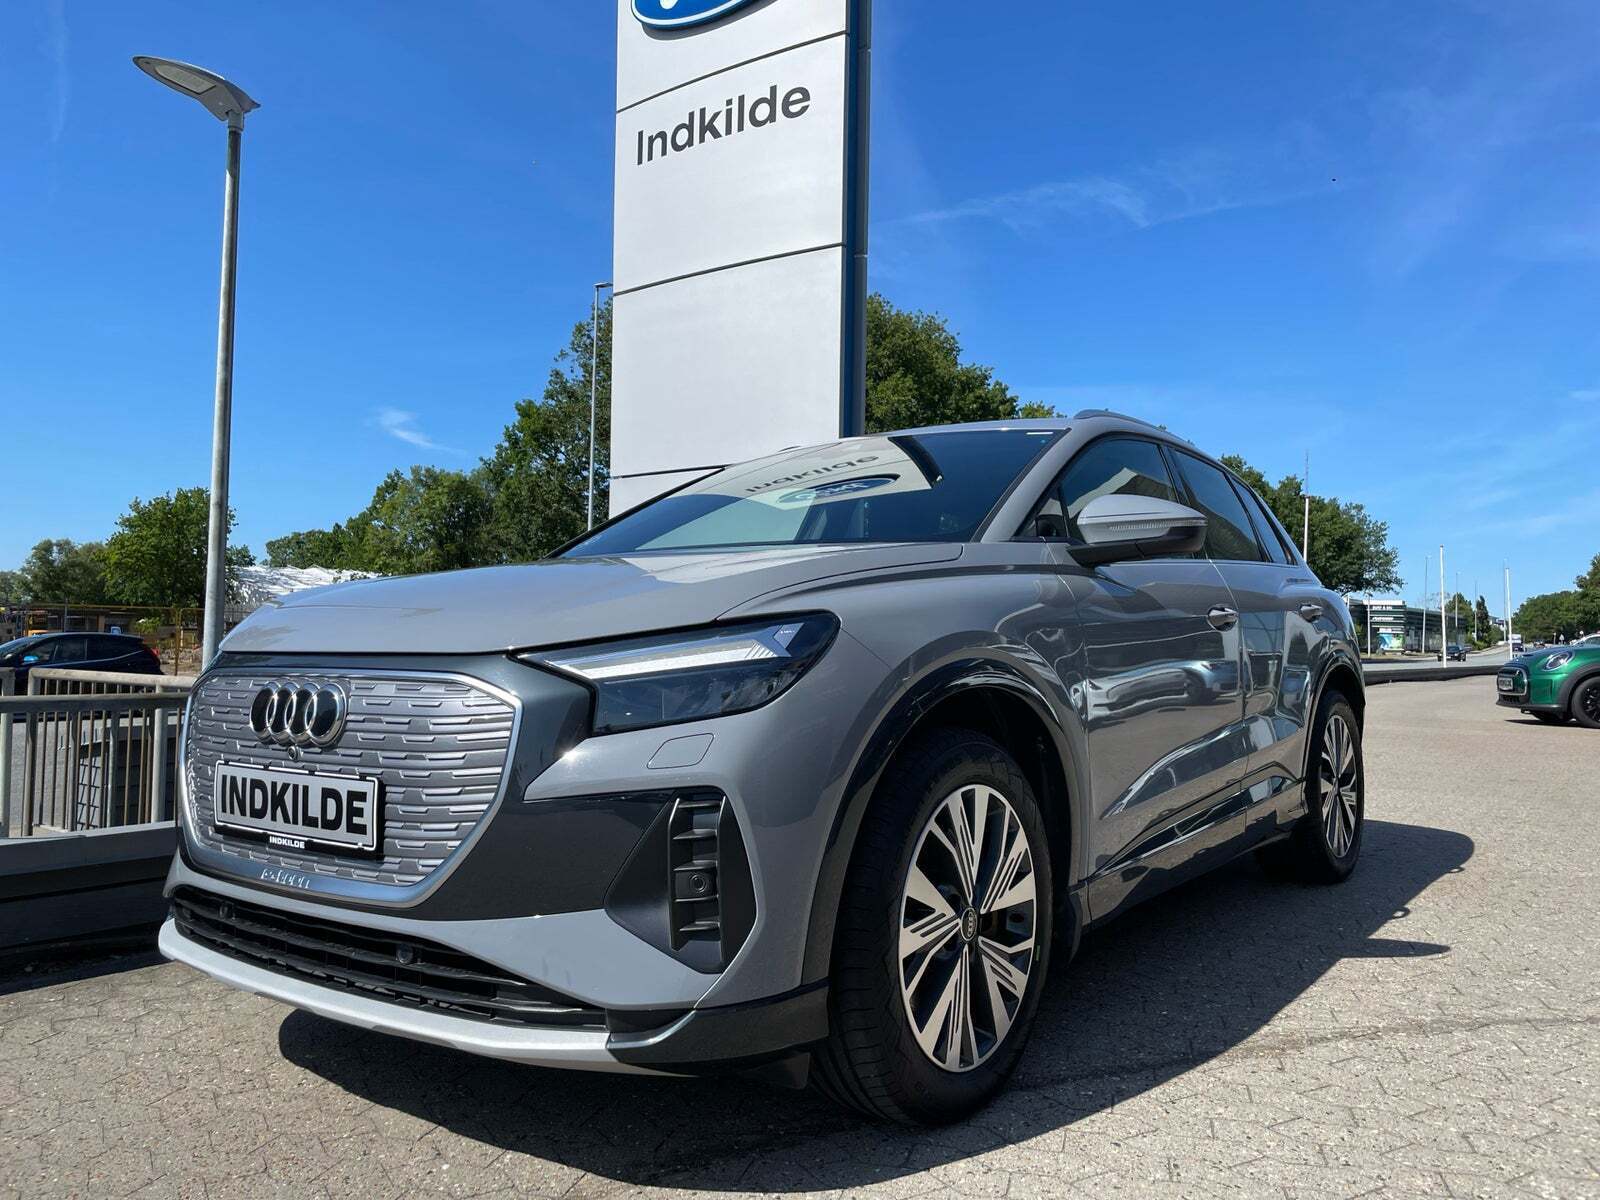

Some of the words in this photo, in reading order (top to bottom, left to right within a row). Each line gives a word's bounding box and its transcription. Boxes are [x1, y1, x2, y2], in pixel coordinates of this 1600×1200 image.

[637, 84, 811, 166] Indkilde
[221, 774, 368, 835] INDKILDE
[269, 835, 306, 849] INDKILDE
